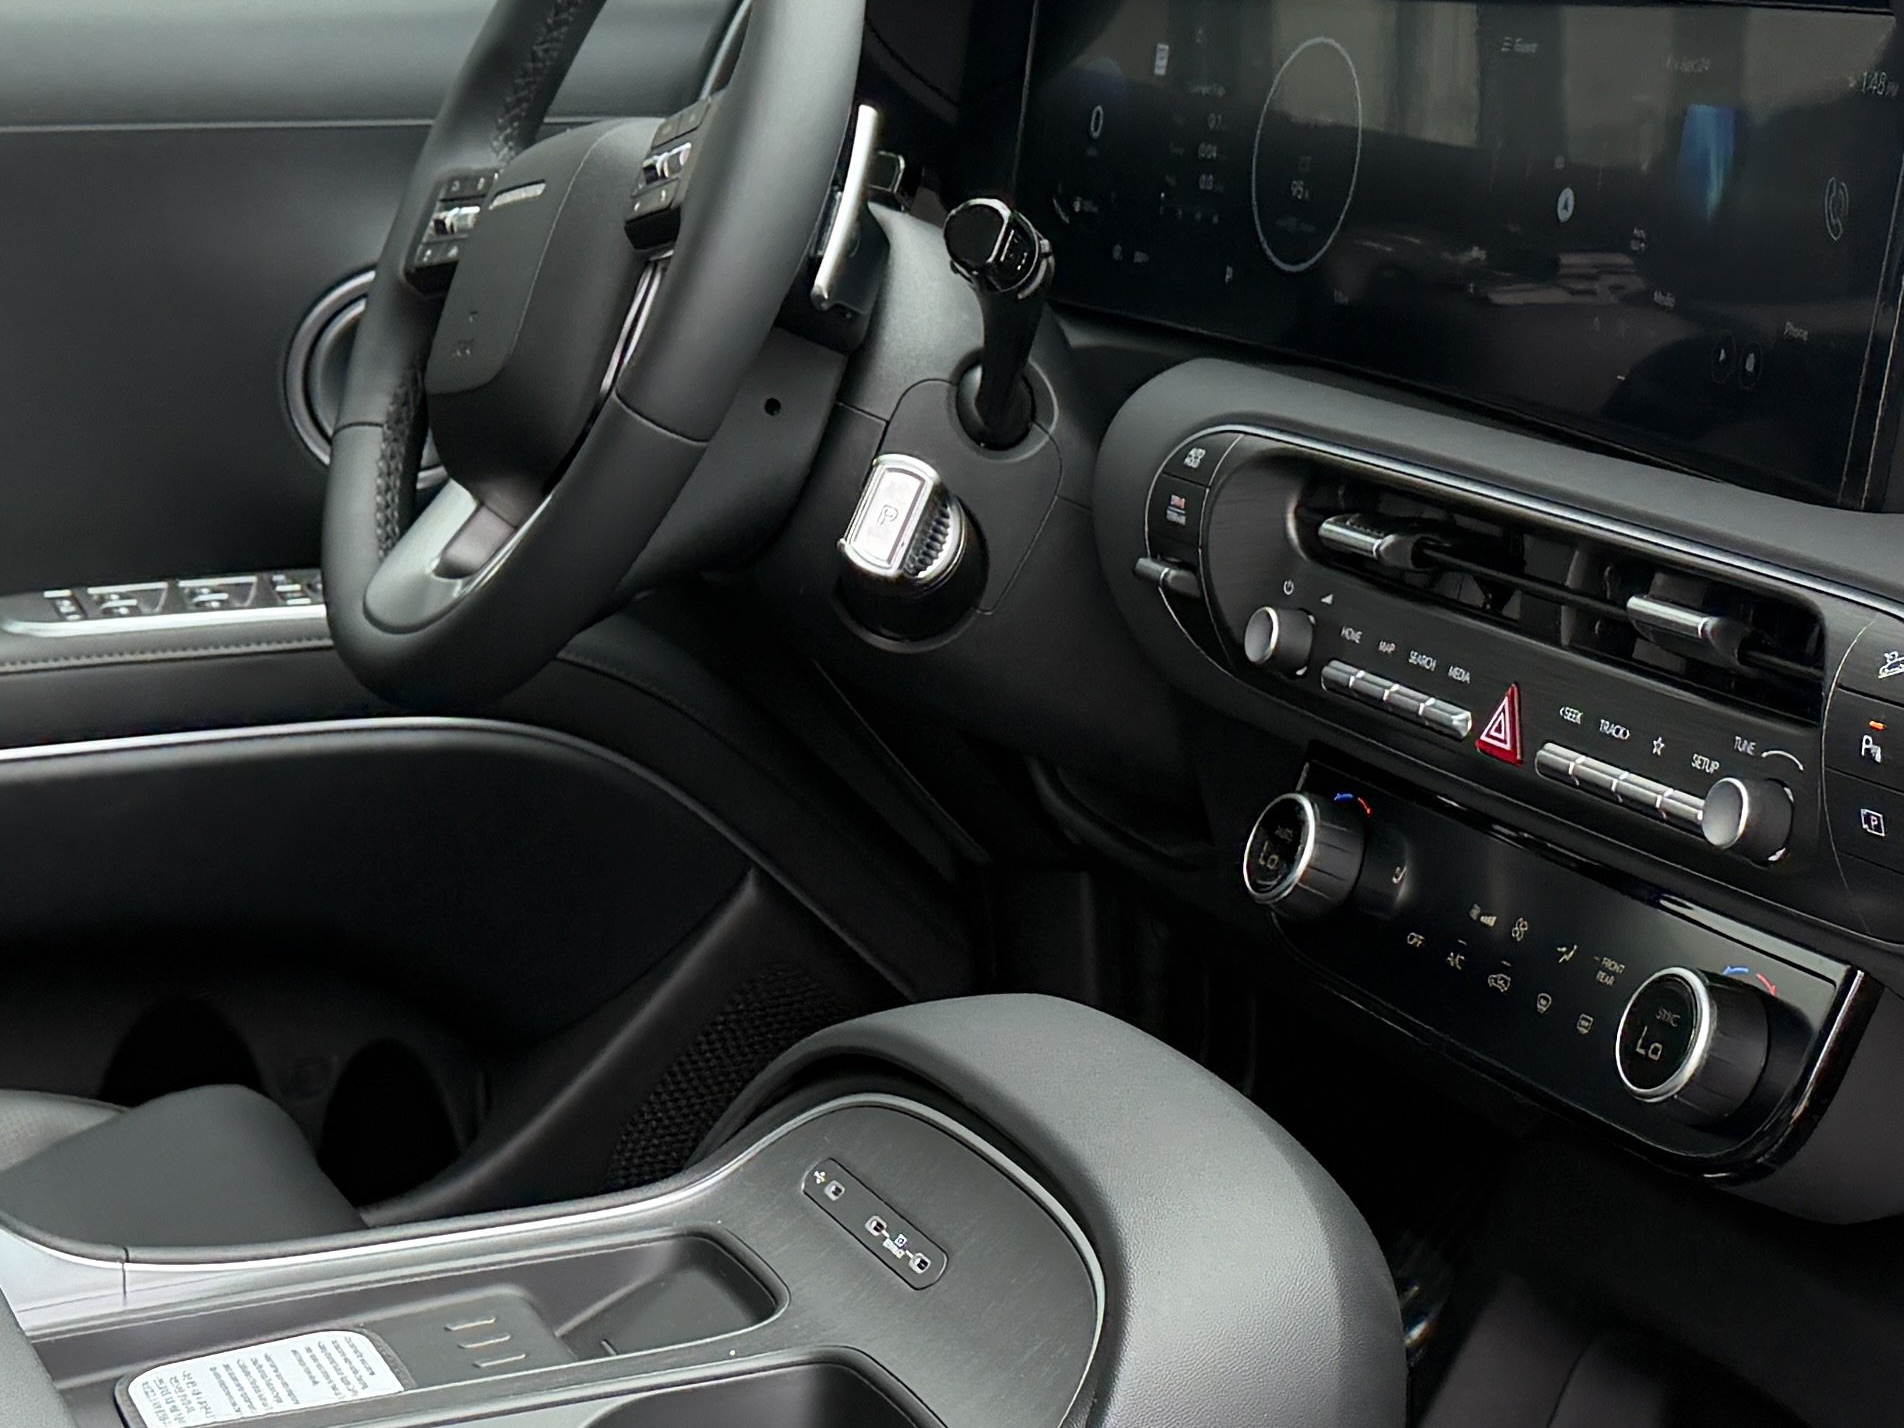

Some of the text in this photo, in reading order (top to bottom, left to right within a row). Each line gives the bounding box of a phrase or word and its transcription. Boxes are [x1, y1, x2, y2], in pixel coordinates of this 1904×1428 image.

[1089, 104, 1104, 140] 0
[1783, 320, 1808, 342] Phone
[1340, 625, 1363, 645] HOME
[1377, 639, 1397, 654] MAP
[1407, 649, 1437, 673] SEARCH
[1447, 664, 1472, 685] MEDIA
[1733, 735, 1757, 757] TUNE
[1691, 752, 1721, 776] SETUP
[1406, 932, 1426, 949] OFF
[1444, 951, 1466, 971] A/C
[1600, 956, 1627, 975] FRONT
[1596, 970, 1616, 987] REAR
[1655, 1005, 1681, 1028] SYNC
